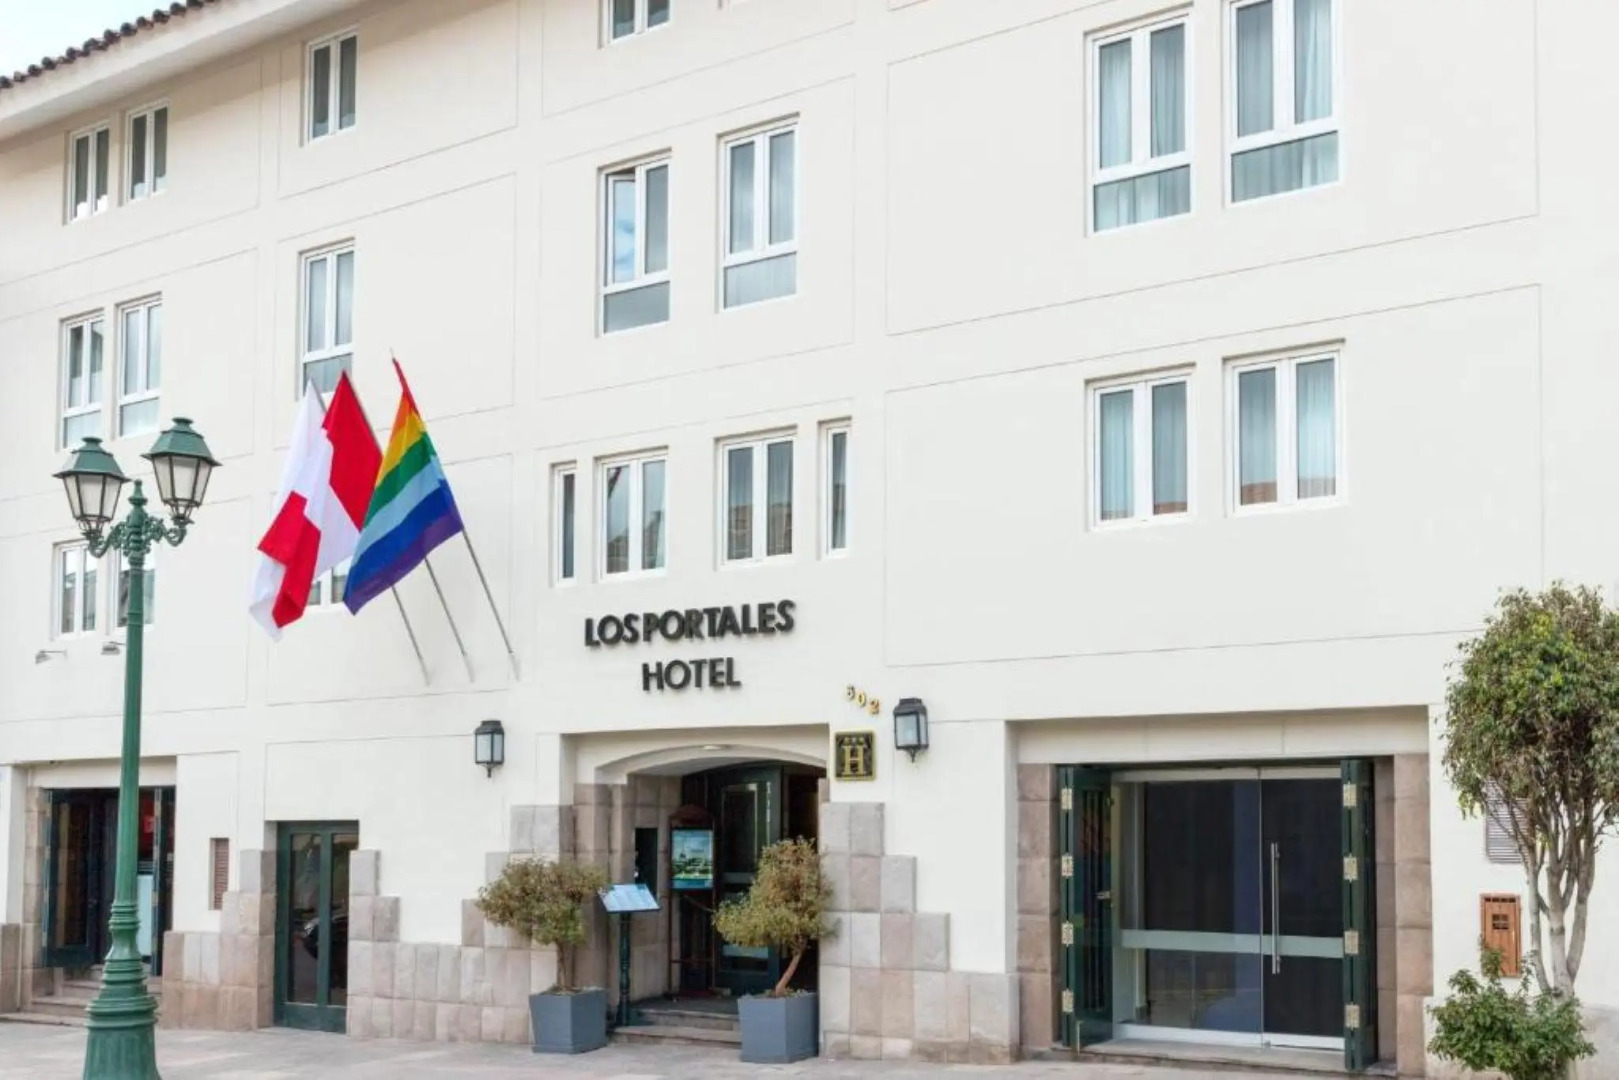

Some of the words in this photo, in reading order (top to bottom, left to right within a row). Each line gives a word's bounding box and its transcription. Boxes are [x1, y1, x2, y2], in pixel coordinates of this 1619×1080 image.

[584, 612, 640, 647] LOS
[642, 600, 796, 642] PORTALES
[642, 657, 742, 692] HOTEL
[842, 744, 868, 776] H
